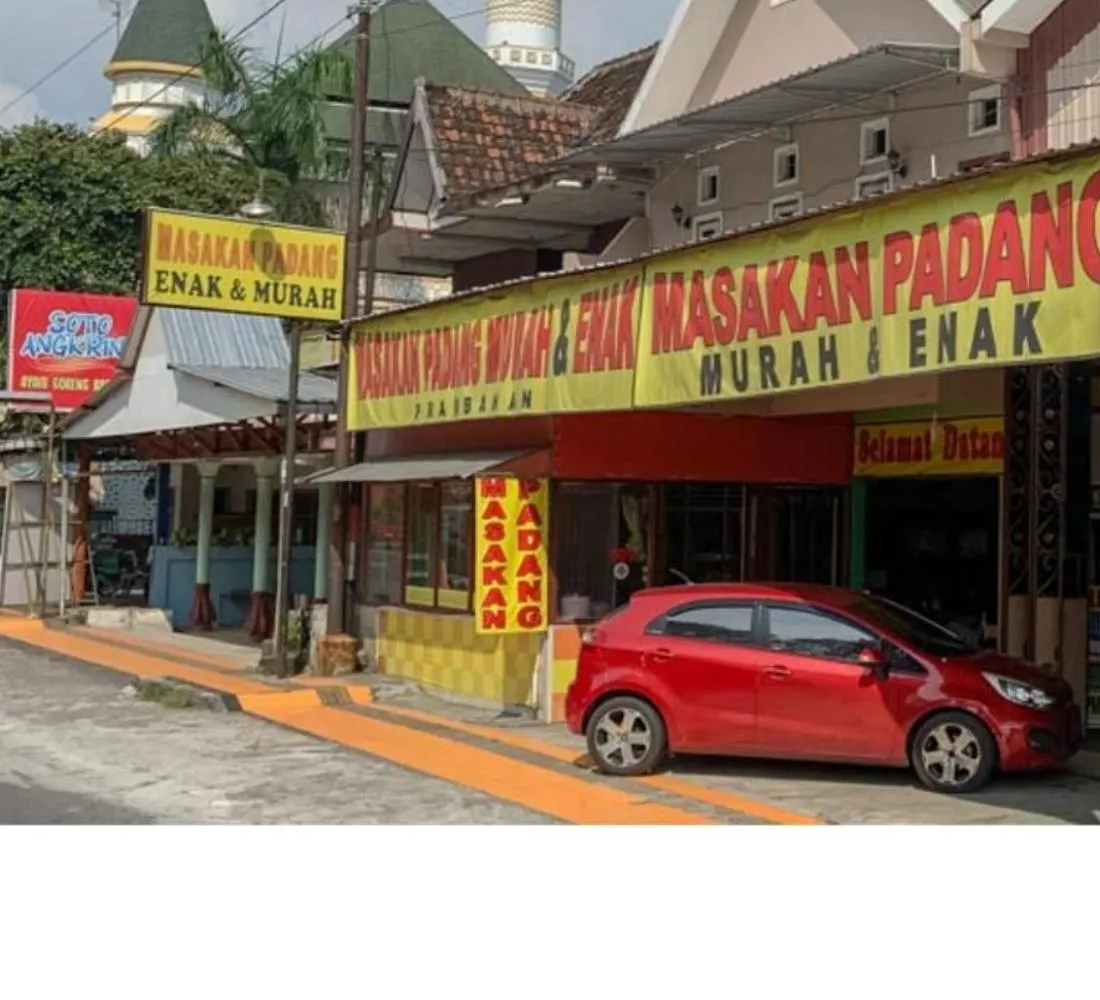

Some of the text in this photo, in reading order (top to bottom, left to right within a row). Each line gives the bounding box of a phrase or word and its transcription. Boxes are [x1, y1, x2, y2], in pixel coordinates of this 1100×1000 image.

[155, 270, 337, 310] ENAK & MURAH
[157, 222, 339, 280] MASAKAN PADANG
[651, 240, 872, 355] MASAKAN
[553, 298, 570, 376] &
[572, 275, 640, 374] ENAK
[699, 300, 1043, 396] MURAH & ENAK
[858, 427, 932, 464] Selamat
[481, 476, 507, 630] MASAKAN
[516, 477, 542, 630] PADANG
